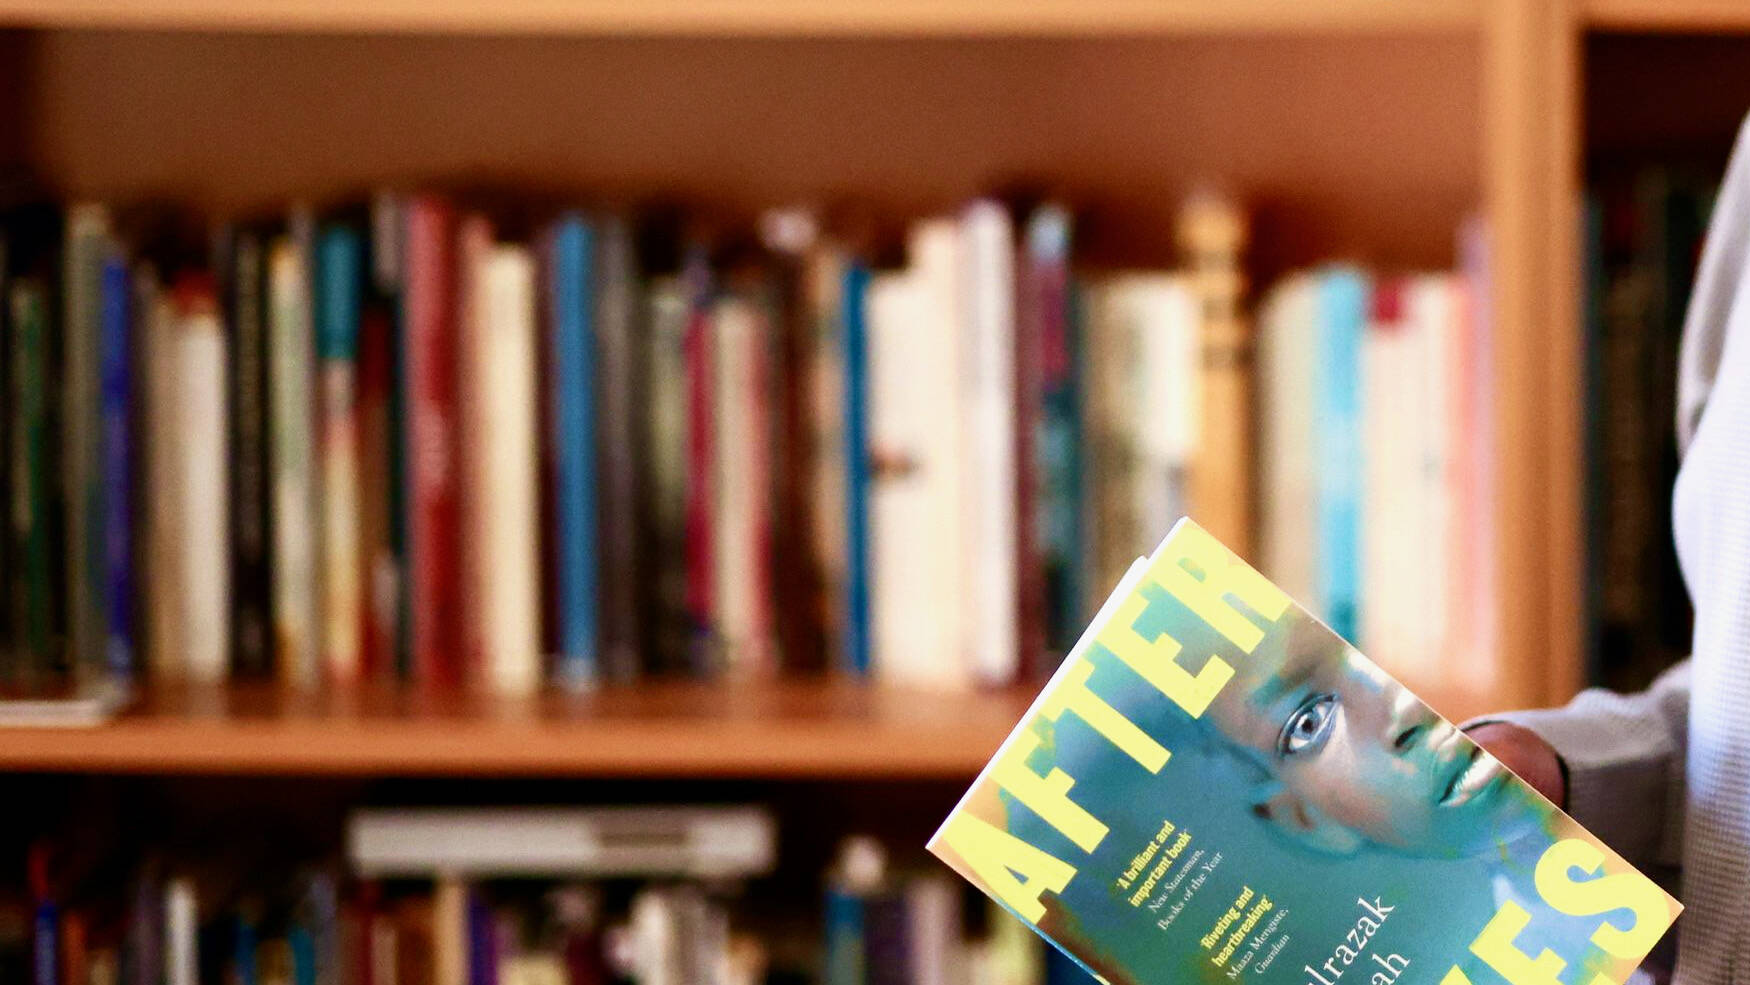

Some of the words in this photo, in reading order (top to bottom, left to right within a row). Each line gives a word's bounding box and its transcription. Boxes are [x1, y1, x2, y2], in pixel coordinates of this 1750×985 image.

[941, 525, 1293, 924] AFTER
[1123, 841, 1160, 881] brilliant
[1156, 820, 1176, 844] and
[1127, 856, 1173, 907] important
[1148, 892, 1169, 913] New
[1164, 849, 1206, 893] Statesman,
[1157, 901, 1186, 931] Books
[1183, 887, 1194, 901] of
[1190, 873, 1208, 891] the
[1201, 852, 1223, 873] Year
[1235, 885, 1255, 910] and
[1439, 838, 1670, 985] ES
[1226, 950, 1255, 980] Maaza
[1250, 908, 1289, 950] Mengiste,
[1254, 934, 1290, 974] Guardian
[1303, 895, 1396, 985] lrazak
